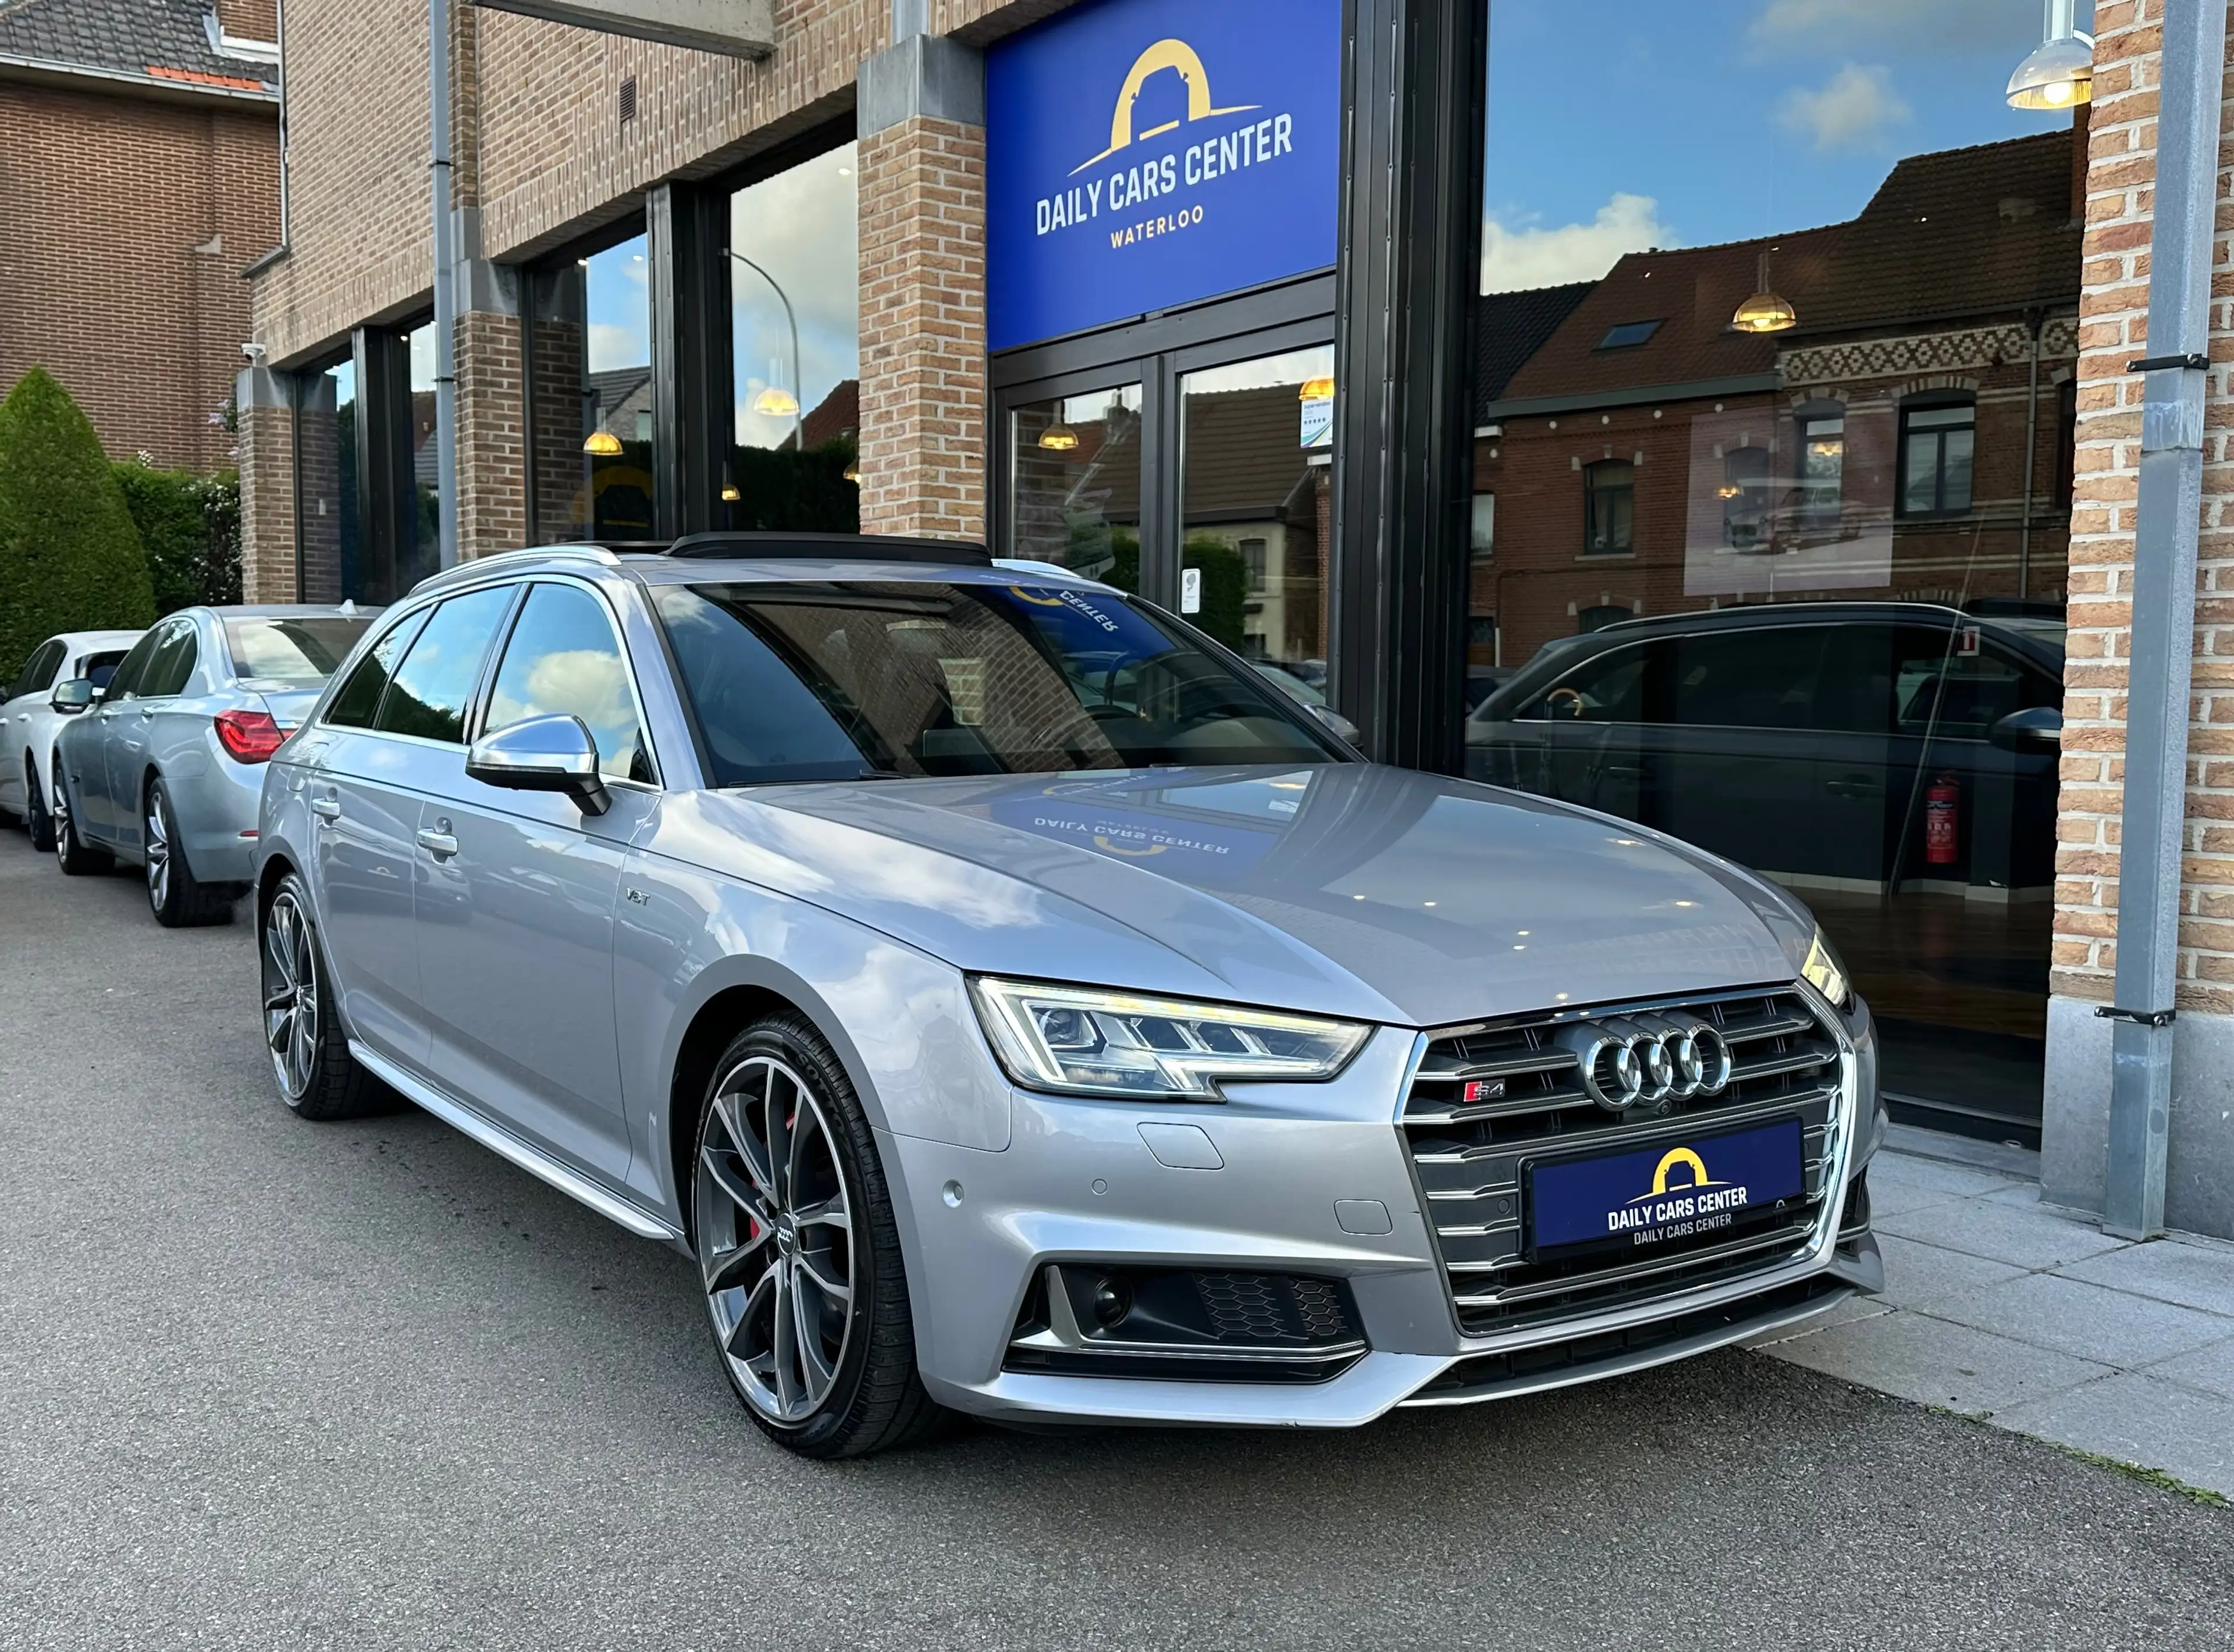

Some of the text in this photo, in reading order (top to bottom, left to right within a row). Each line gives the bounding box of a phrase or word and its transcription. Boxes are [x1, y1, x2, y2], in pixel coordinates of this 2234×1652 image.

[1036, 113, 1292, 235] DAILY CARS CENTER
[1111, 205, 1203, 248] WATERLOO
[1608, 1187, 1747, 1230] DAILY CARS CENTER
[1634, 1213, 1732, 1245] DAILY CARS CENTER
